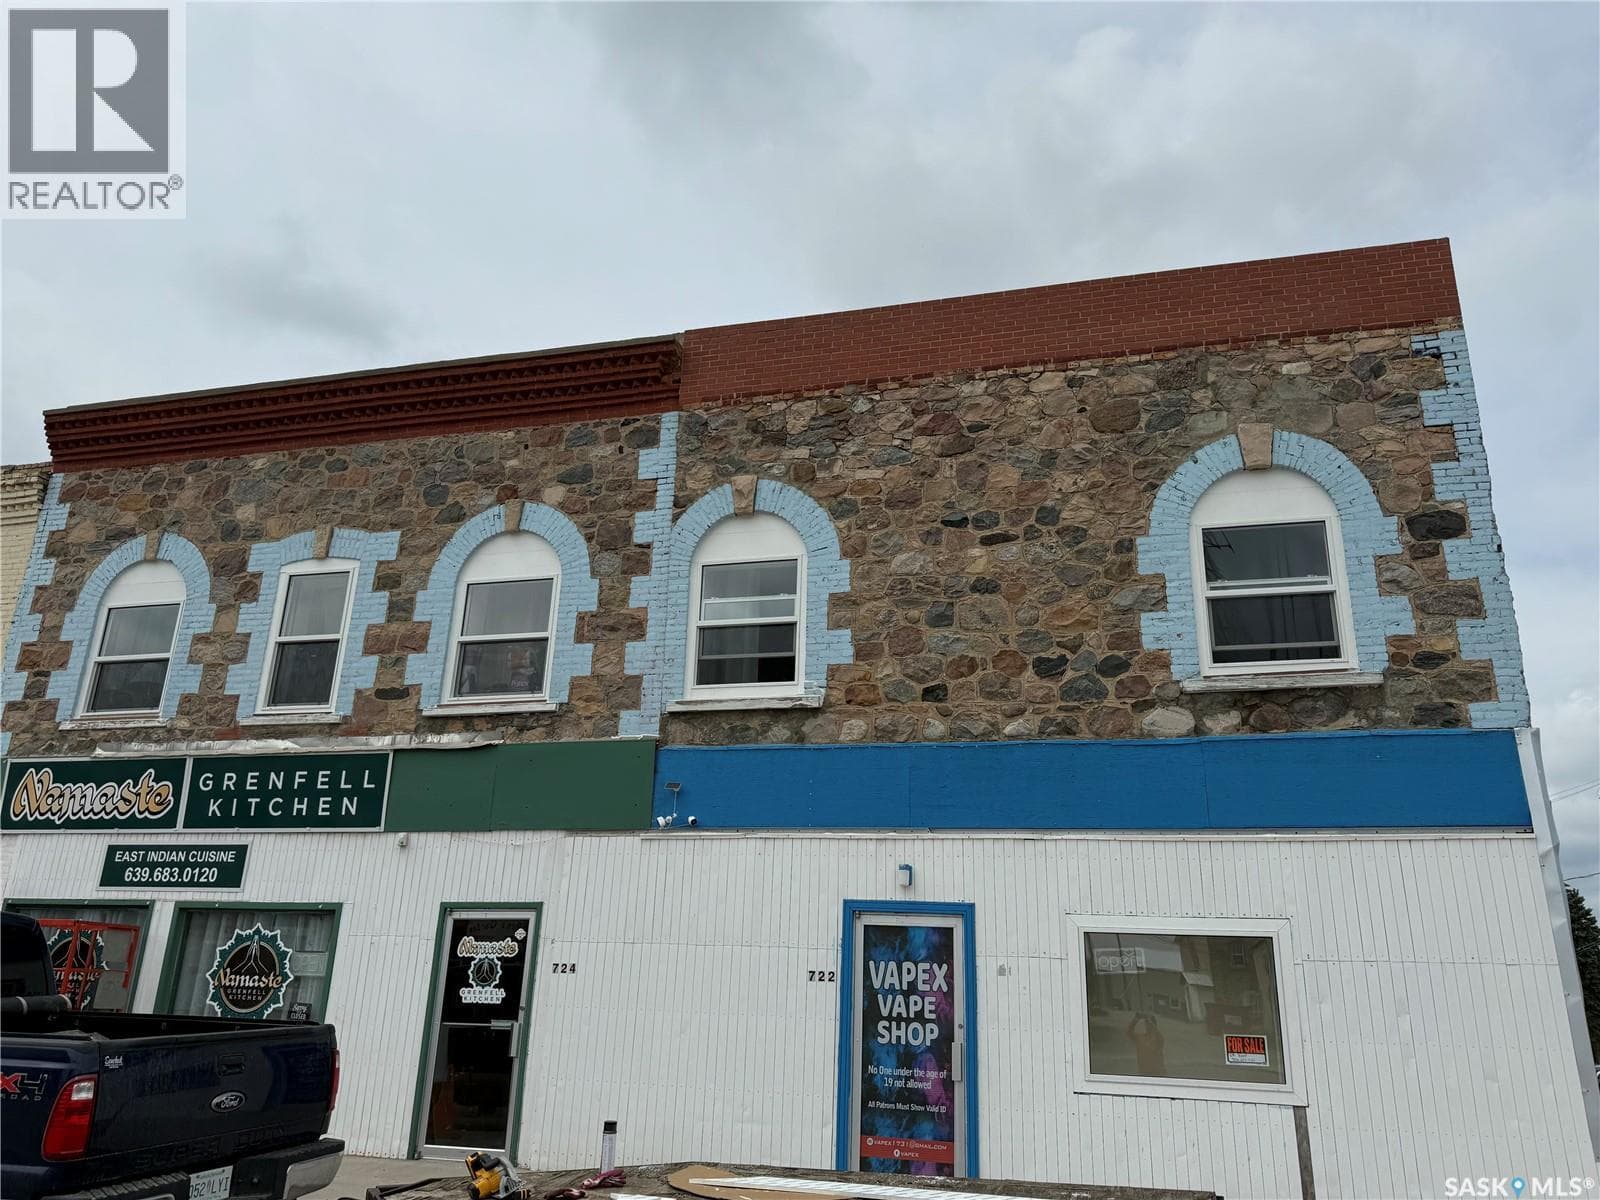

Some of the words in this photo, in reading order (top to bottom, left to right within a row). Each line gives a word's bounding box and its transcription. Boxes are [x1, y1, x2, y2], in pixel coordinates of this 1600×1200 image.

[198, 769, 376, 791] GRENFELL
[10, 767, 174, 824] Namaste
[207, 796, 358, 817] KITCHEN
[114, 850, 145, 862] EAST
[146, 850, 186, 862] INDIAN
[188, 850, 236, 862] CUISINE
[124, 866, 218, 883] 639.683.0120
[458, 936, 519, 957] Namaste
[552, 963, 576, 974] 724
[808, 970, 836, 982] 722
[868, 960, 949, 992] VAPEX
[214, 968, 282, 988] Namaste
[461, 988, 505, 997] GRENFELL
[877, 993, 937, 1019] VAPE
[877, 1020, 939, 1047] SHOP
[1227, 1036, 1243, 1053] FOR
[1244, 1037, 1265, 1054] SALE
[868, 1065, 878, 1074] No
[879, 1066, 892, 1075] One
[893, 1067, 913, 1077] under
[914, 1068, 925, 1078] the
[926, 1070, 939, 1080] age
[940, 1070, 947, 1079] of
[884, 1077, 893, 1087] 19
[894, 1078, 905, 1088] not
[907, 1079, 932, 1089] allowed
[876, 1101, 896, 1110] Patrons
[896, 1102, 909, 1111] Must
[910, 1103, 925, 1112] Show
[925, 1104, 939, 1113] Valid
[940, 1105, 947, 1113] ID
